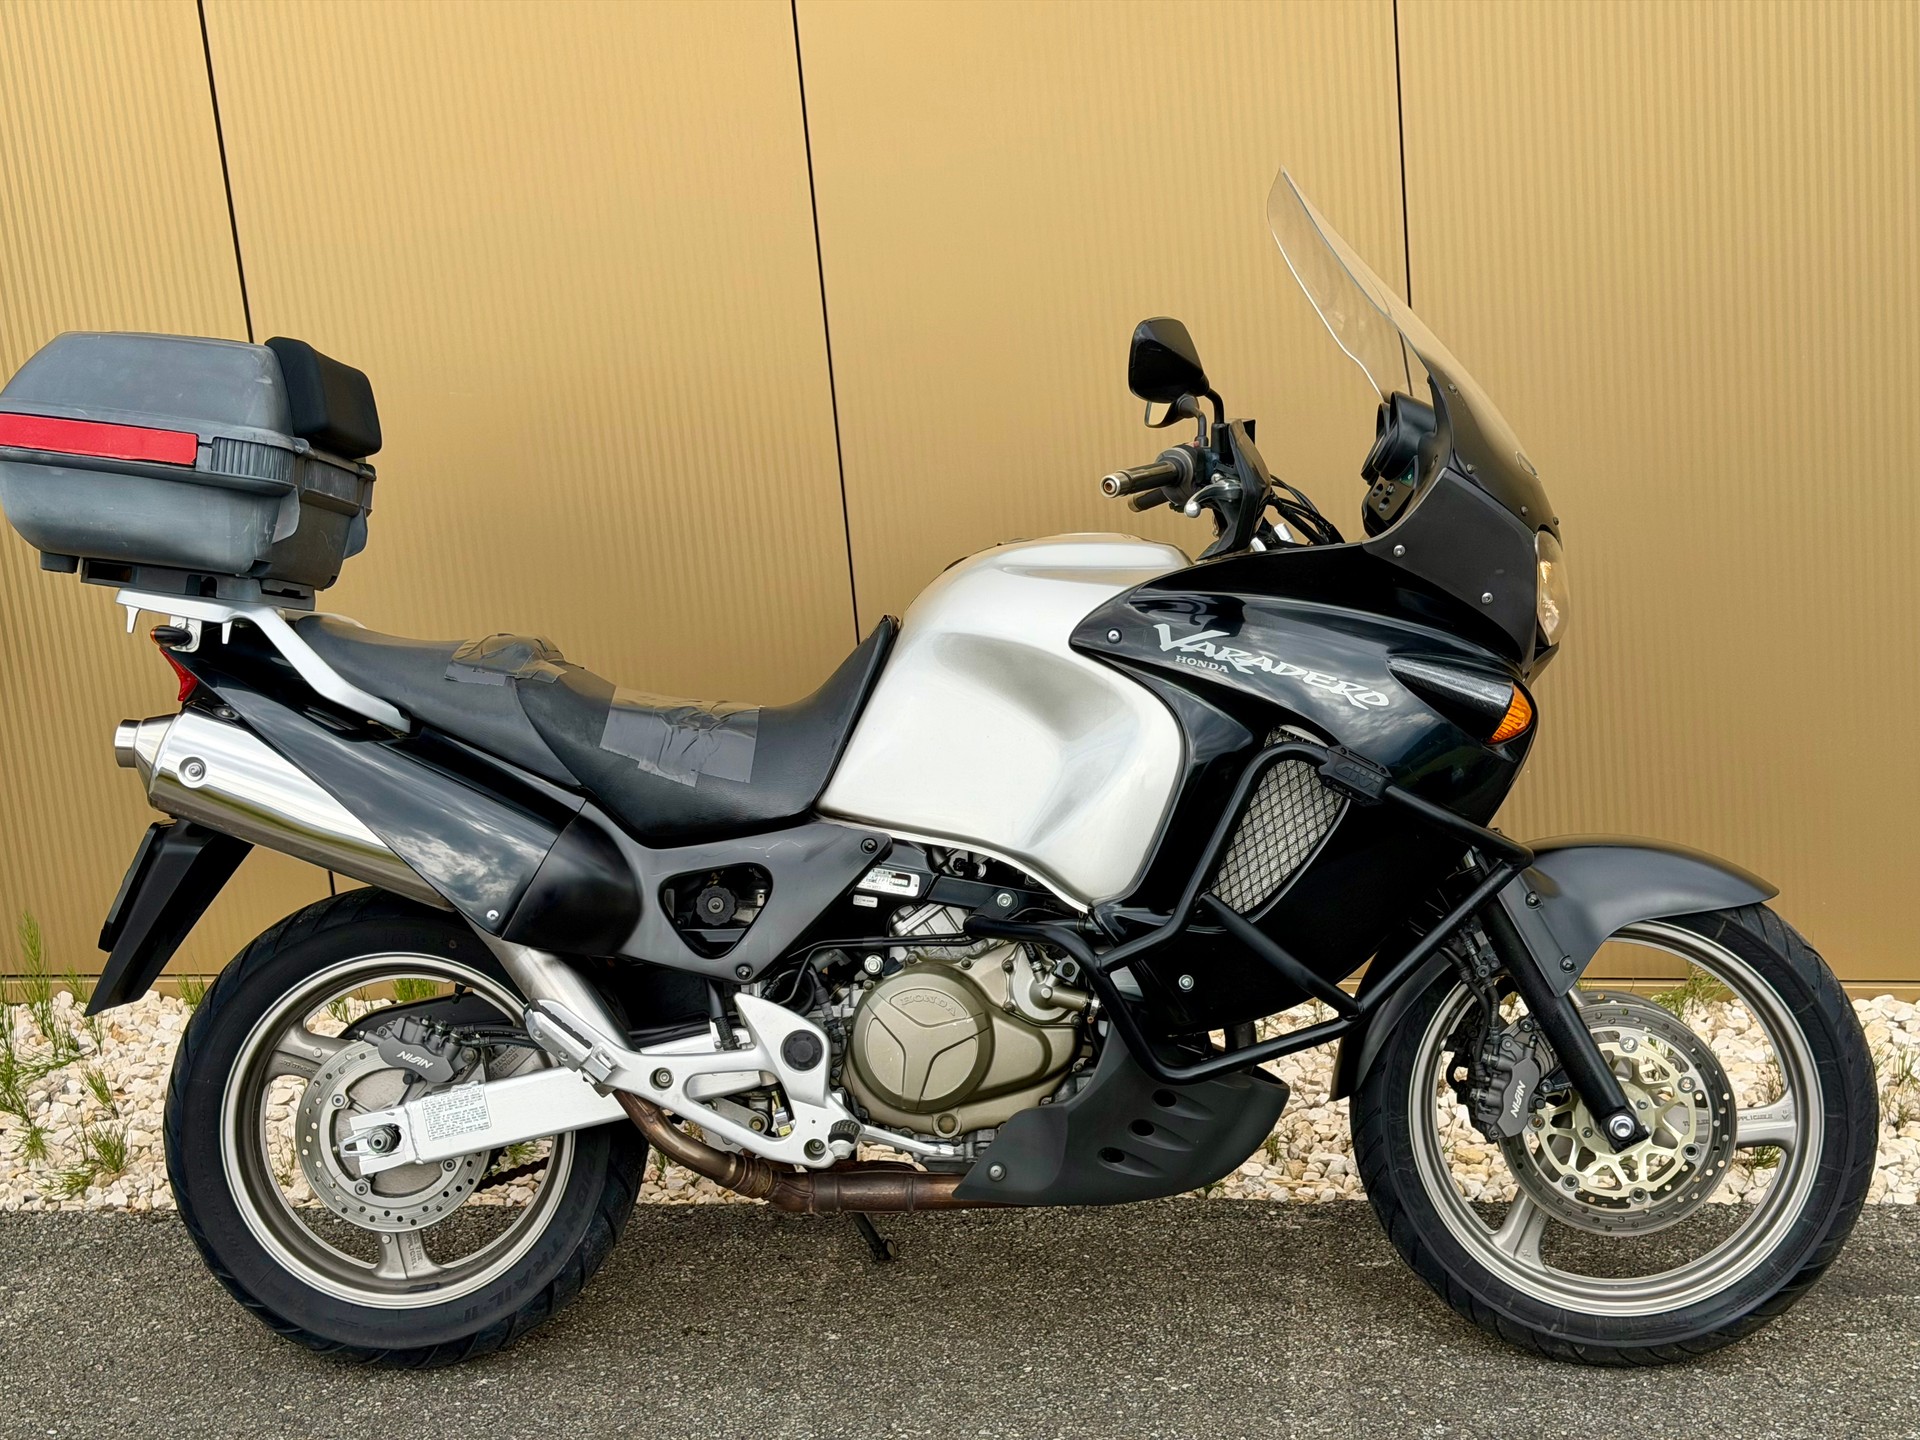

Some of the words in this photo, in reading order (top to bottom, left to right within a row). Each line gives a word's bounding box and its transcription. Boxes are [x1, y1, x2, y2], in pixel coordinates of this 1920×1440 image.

[1153, 623, 1390, 710] VARADERO
[1175, 655, 1230, 673] HONDA
[900, 994, 958, 1017] HONDA
[396, 1050, 434, 1069] NISSIN
[1510, 1080, 1526, 1118] NISSIN
